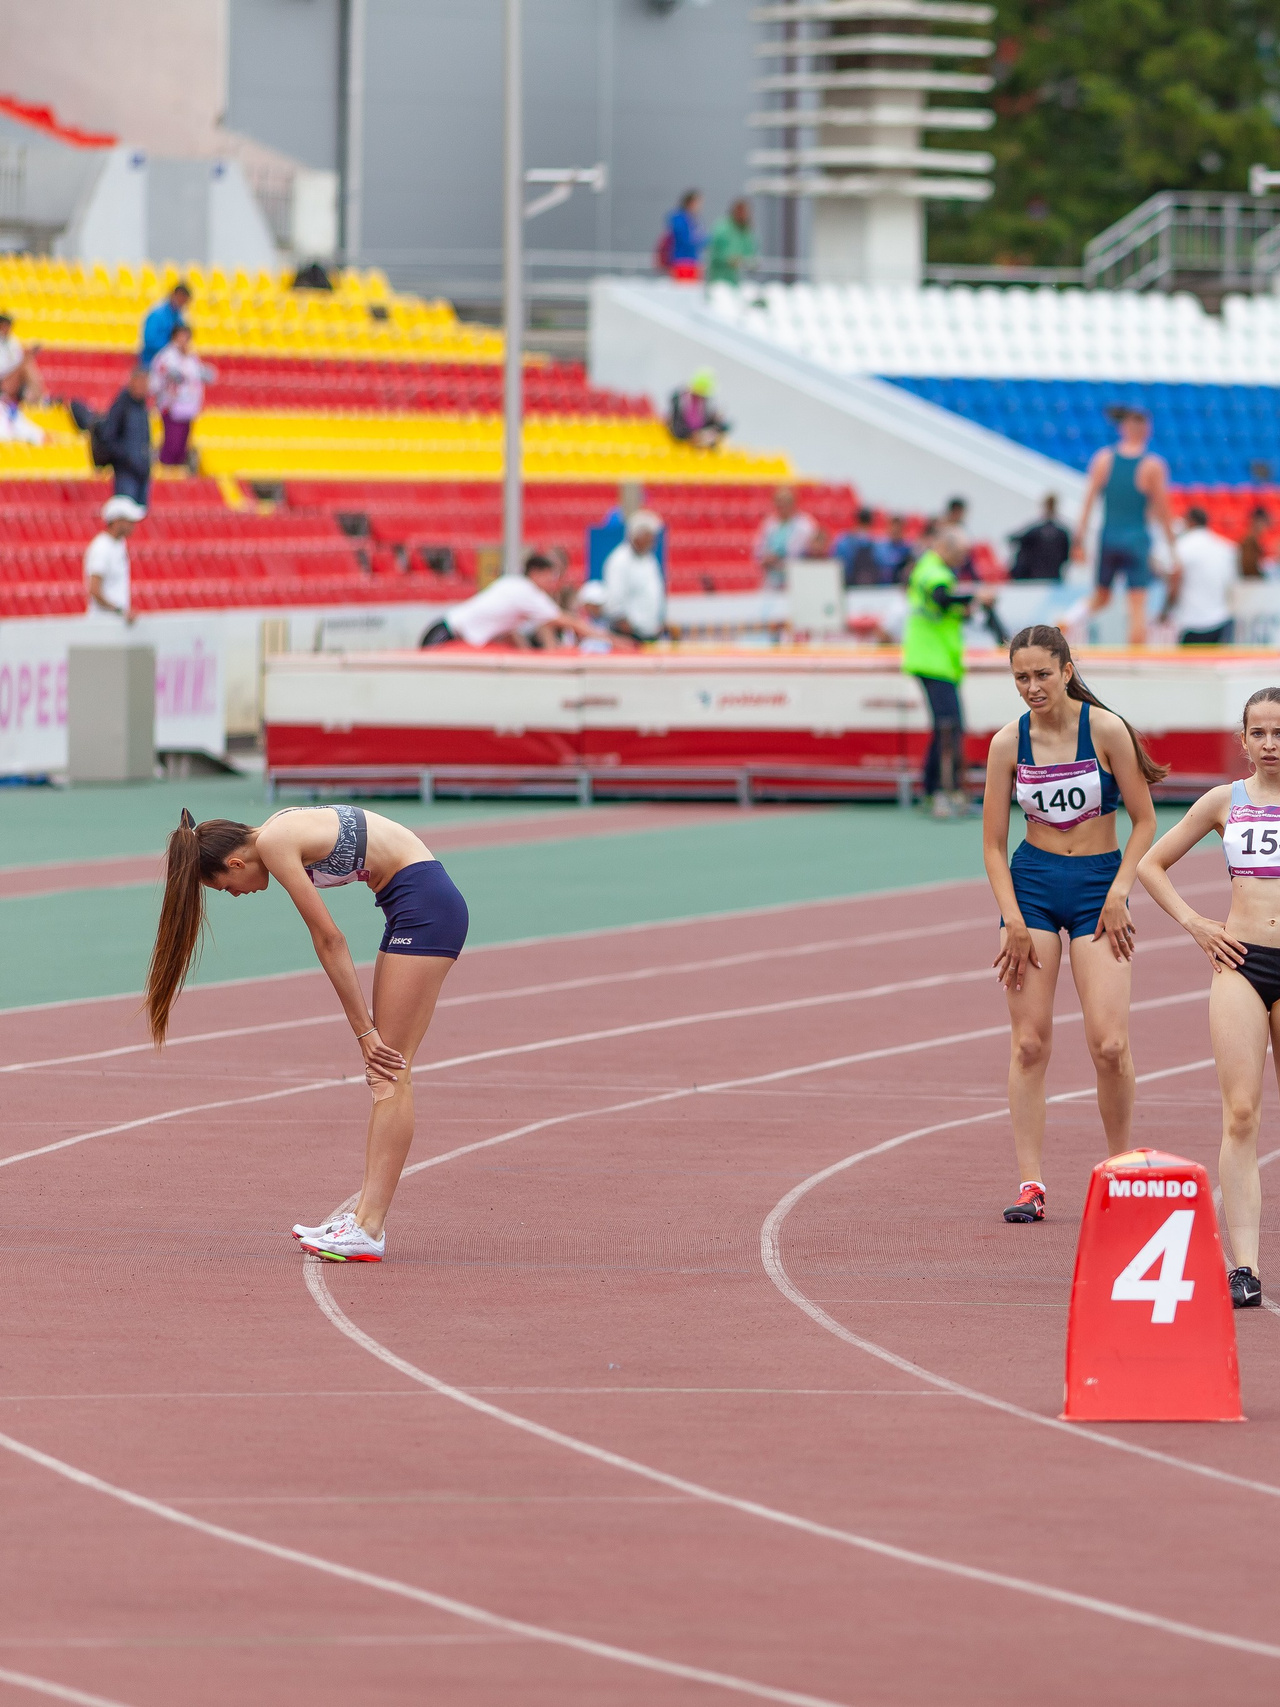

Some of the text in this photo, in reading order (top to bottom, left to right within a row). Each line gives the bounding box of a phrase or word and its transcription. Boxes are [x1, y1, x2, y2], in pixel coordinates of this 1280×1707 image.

[1031, 786, 1086, 813] 140
[1108, 1179, 1198, 1198] MONDO
[1110, 1209, 1196, 1324] 4
